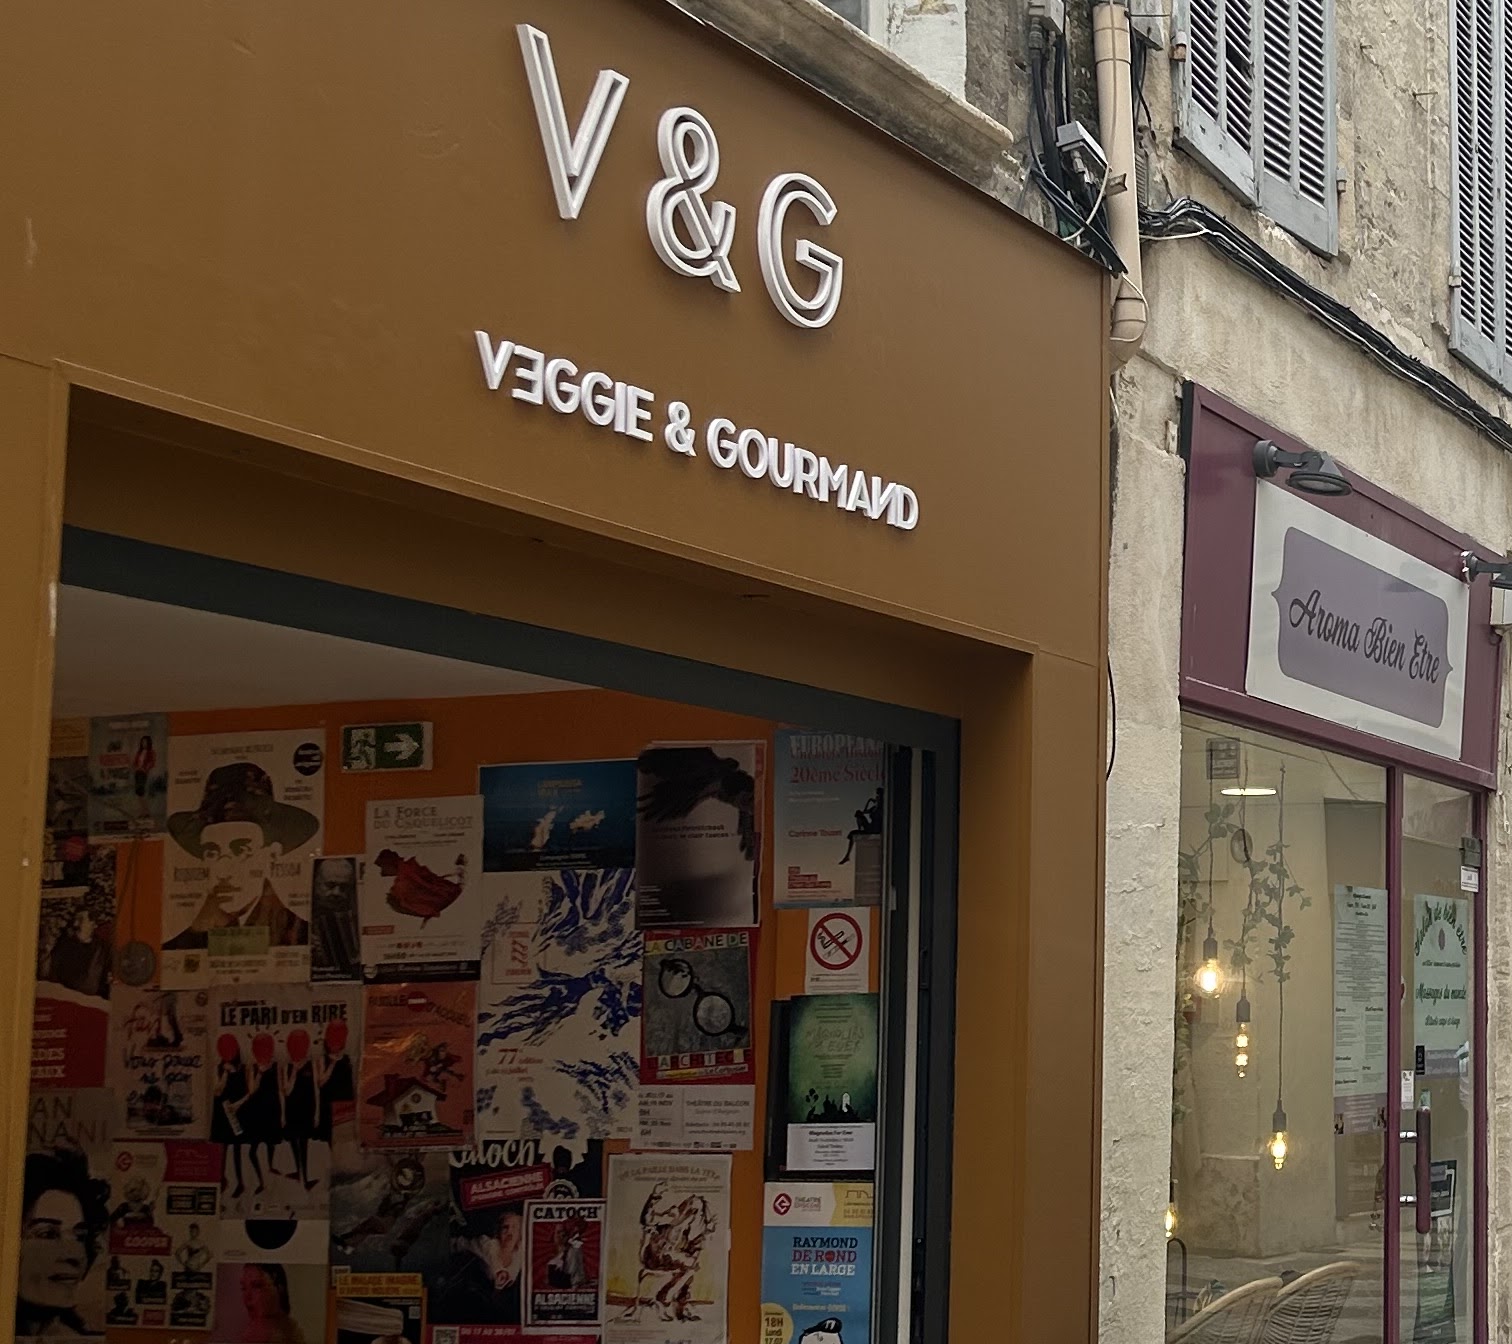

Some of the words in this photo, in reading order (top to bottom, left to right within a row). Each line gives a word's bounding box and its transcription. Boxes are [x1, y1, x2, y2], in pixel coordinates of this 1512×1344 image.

[665, 401, 697, 457] &
[707, 417, 919, 531] GOURMAND
[1289, 589, 1361, 654] Aroma
[1364, 617, 1406, 671] Bien
[1409, 628, 1440, 684] Etre
[665, 935, 723, 951] CABANE
[727, 932, 748, 946] DE
[221, 1007, 236, 1027] LE
[241, 1006, 277, 1026] PARI
[282, 1009, 307, 1024] D'EN
[312, 1004, 348, 1024] RIRE
[533, 1206, 600, 1219] CATOCH
[793, 1237, 858, 1248] RAYMOND
[792, 1250, 812, 1262] DE
[814, 1250, 857, 1262] ROND
[790, 1263, 809, 1275] EN
[810, 1264, 855, 1276] LARGE
[534, 1291, 596, 1306] ALSACIENNE
[765, 1317, 783, 1327] 18H
[765, 1328, 782, 1337] Lundi
